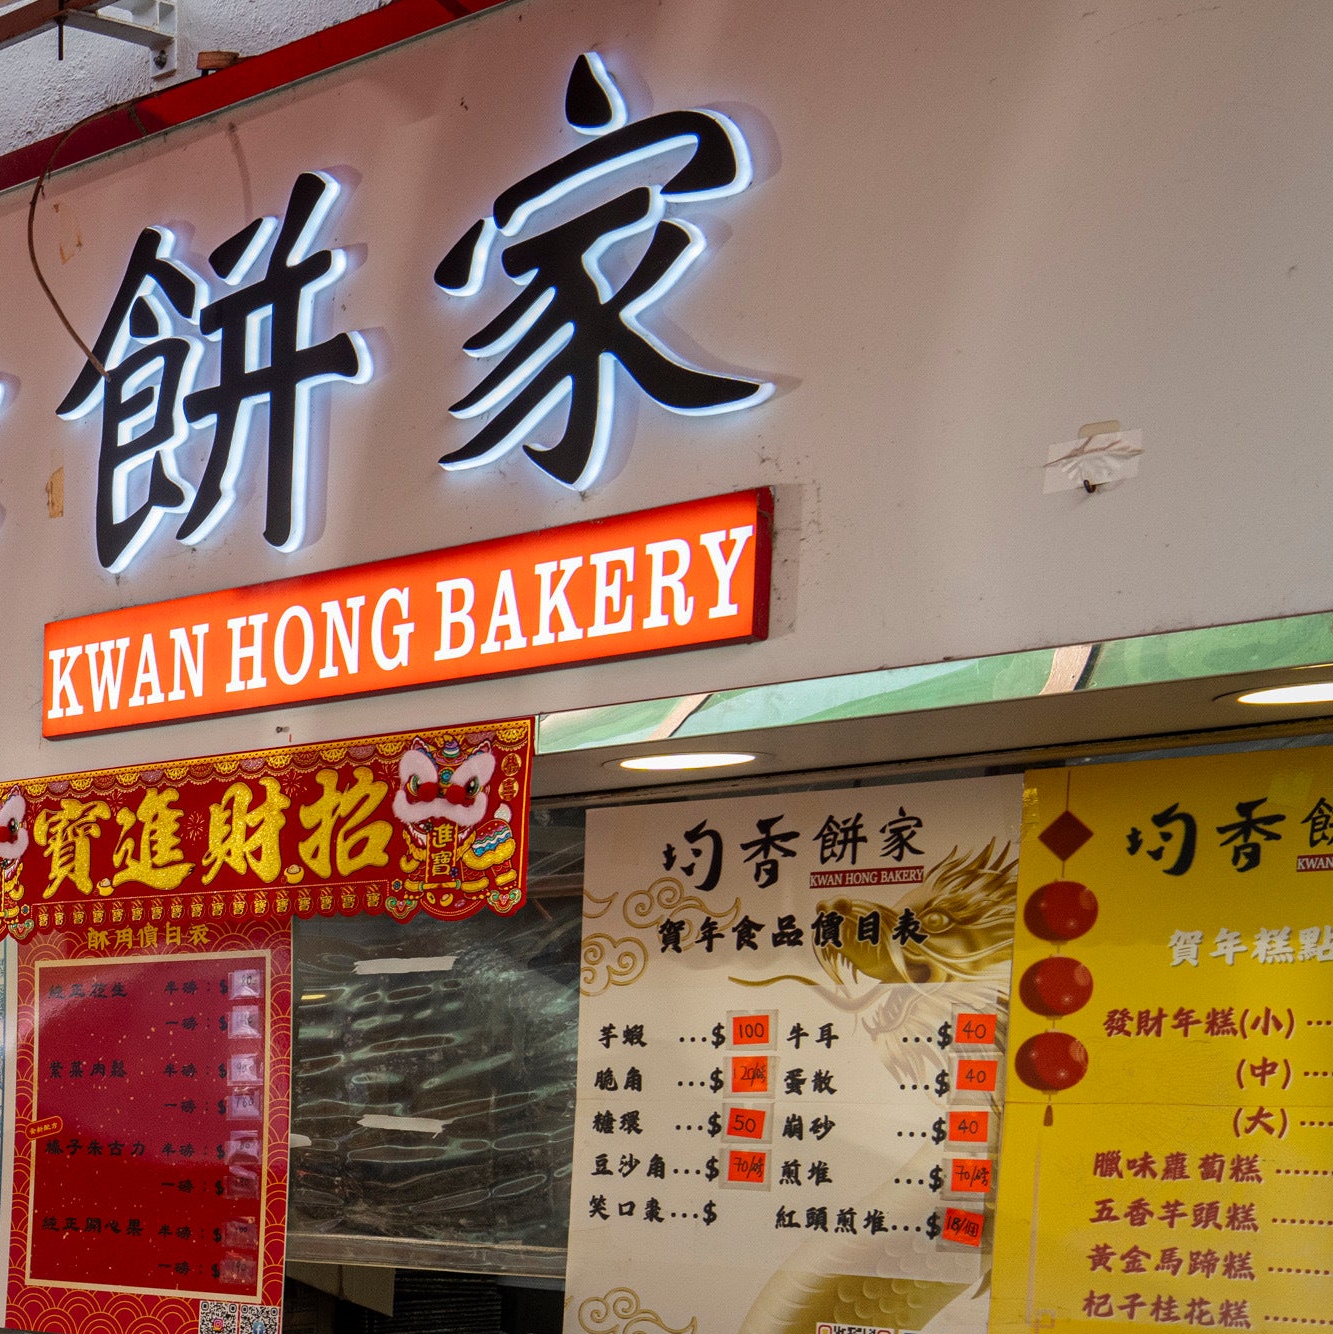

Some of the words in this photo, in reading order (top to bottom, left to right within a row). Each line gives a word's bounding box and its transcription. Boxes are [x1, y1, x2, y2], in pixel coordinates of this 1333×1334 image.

[46, 627, 207, 723] KWAN
[222, 594, 414, 693] HONG
[431, 523, 755, 663] BAKERY
[662, 806, 925, 891] 均香餅家
[1297, 855, 1333, 871] KWAN
[811, 870, 843, 888] KWAN
[846, 869, 879, 886] HONG
[880, 867, 925, 884] BAKERY
[658, 908, 929, 953] 賀年食品價目表
[738, 1022, 765, 1039] 100
[786, 1022, 839, 1049] 牛耳
[962, 1020, 986, 1039] 40
[1103, 1006, 1295, 1040] 發財年糕(小)
[783, 1067, 837, 1095] 蛋散
[964, 1069, 987, 1084] 40
[1236, 1053, 1293, 1090] (中)
[592, 1110, 643, 1135] 糖環
[733, 1114, 756, 1133] 50
[781, 1114, 836, 1141] 崩砂
[958, 1119, 979, 1133] 40
[1232, 1105, 1288, 1139] (大)
[591, 1153, 666, 1179] 豆沙角
[778, 1159, 833, 1186] 煎堆
[775, 1205, 889, 1235] 紅頭煎堆
[1088, 1197, 1259, 1232] 五香芋頭糕
[1082, 1289, 1251, 1330] 杞子桂花糕
